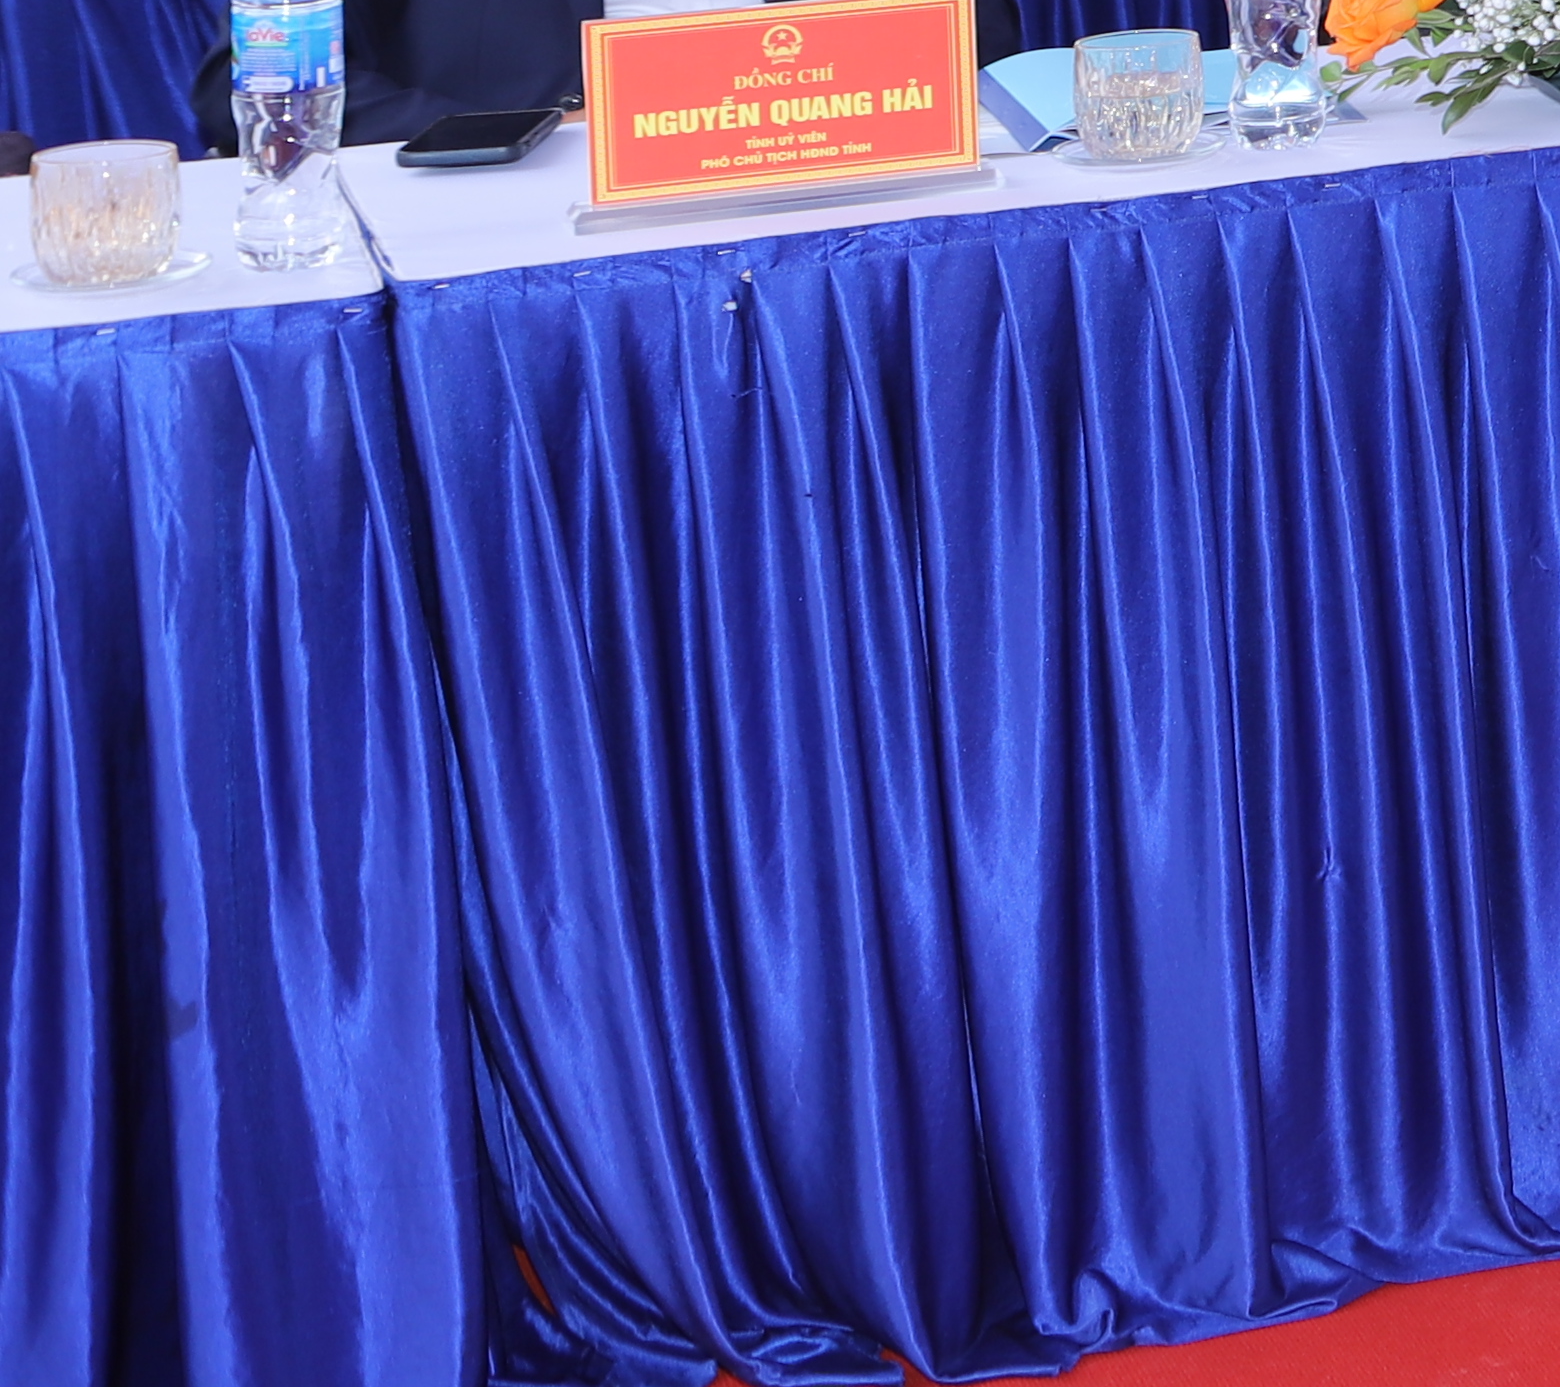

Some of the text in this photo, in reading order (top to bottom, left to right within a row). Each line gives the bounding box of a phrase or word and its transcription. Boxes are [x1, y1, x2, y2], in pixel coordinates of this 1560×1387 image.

[734, 62, 835, 91] ĐỒNG CHÍ
[633, 78, 934, 139] NGUYỄN QUANG HẢI
[745, 134, 775, 150] TỈNH
[799, 129, 827, 146] VIÊN
[700, 140, 872, 170] PHÓ CHỦ TỊCH HĐND TỈNH
